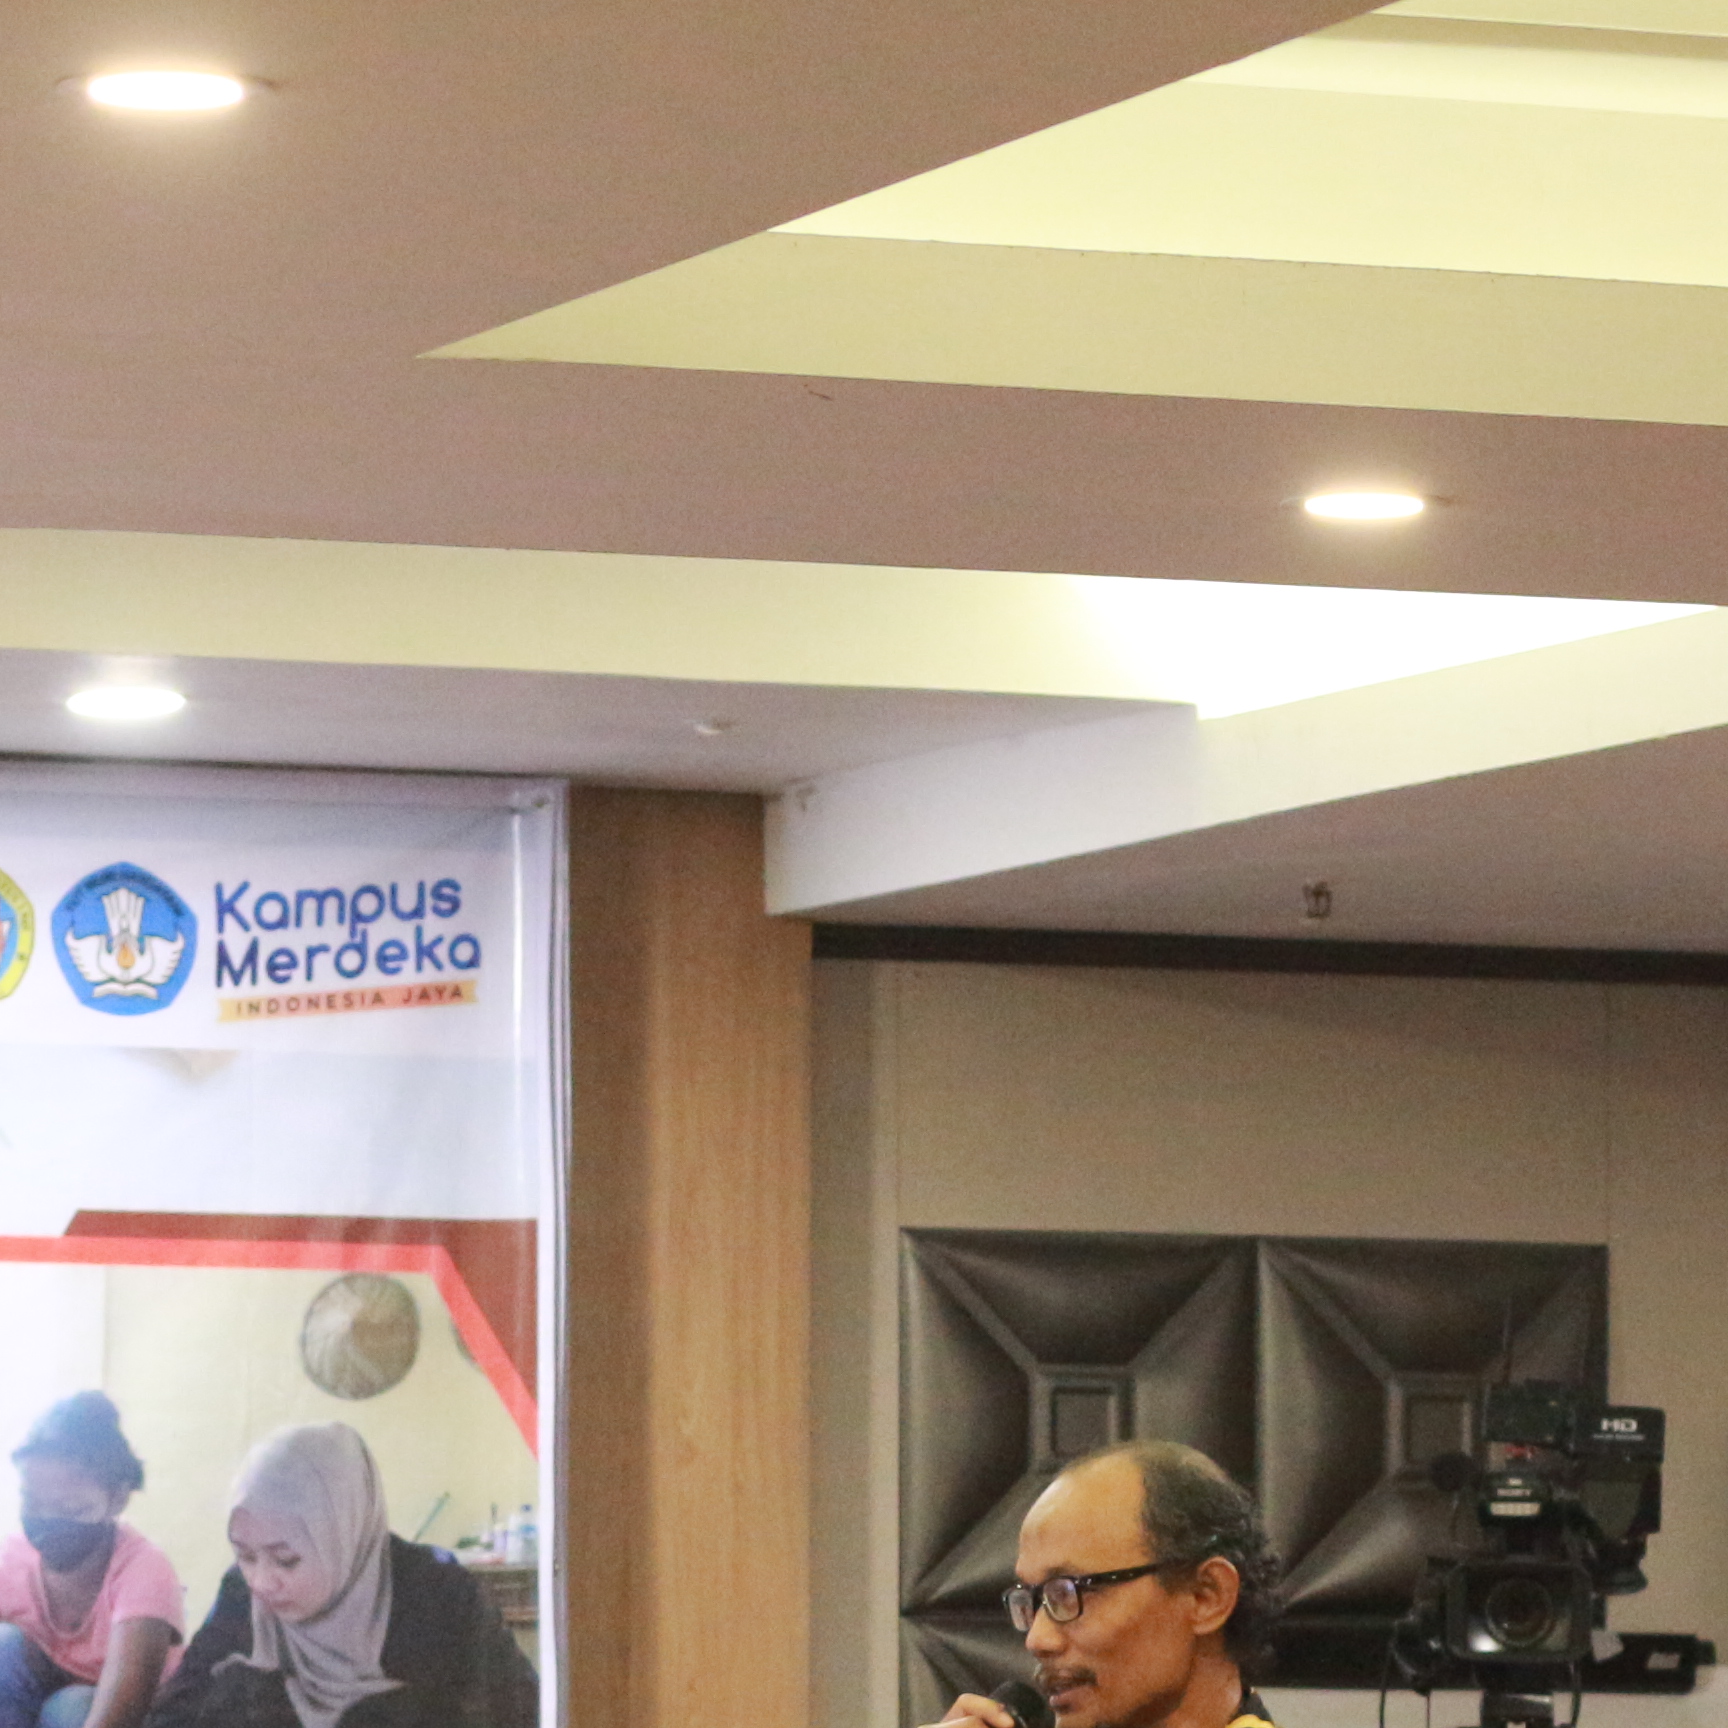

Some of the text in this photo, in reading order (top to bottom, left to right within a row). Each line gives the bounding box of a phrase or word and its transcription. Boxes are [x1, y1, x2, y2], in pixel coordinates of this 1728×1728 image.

[214, 877, 462, 939] Kampus
[215, 924, 482, 988] Merdeka
[235, 983, 463, 1016] INDONESIA JAYA
[1600, 1418, 1638, 1433] HD
